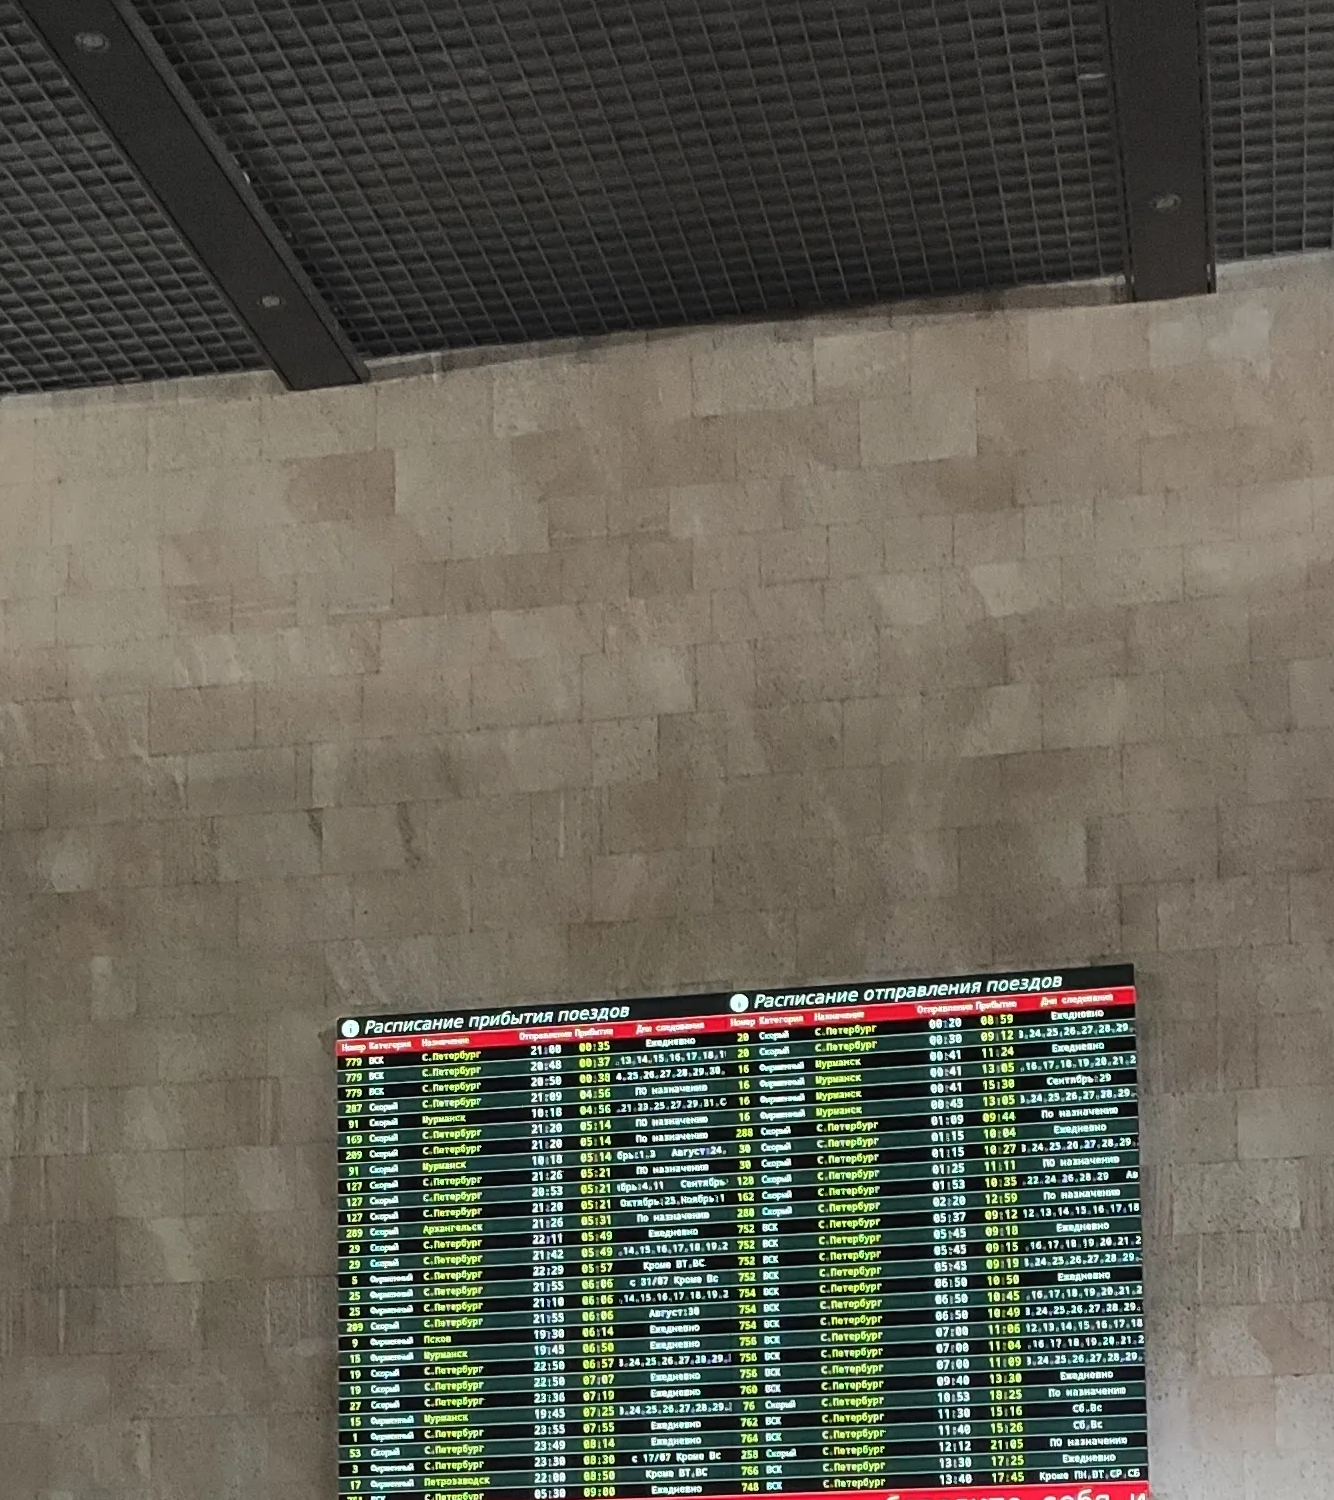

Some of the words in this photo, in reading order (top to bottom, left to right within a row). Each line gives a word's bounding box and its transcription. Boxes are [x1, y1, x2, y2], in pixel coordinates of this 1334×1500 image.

[754, 991, 858, 1008] Расписание
[863, 980, 981, 1002] отправления
[986, 975, 1063, 994] поездов
[365, 1019, 462, 1035] Расписание
[469, 1011, 553, 1030] прибытия
[558, 1006, 630, 1024] поездов
[730, 1018, 756, 1028] Номер
[759, 1015, 803, 1025] Категория
[759, 1030, 790, 1041] Скорый
[815, 1024, 877, 1037] С.Петербург
[342, 1043, 366, 1052] Номер
[369, 1040, 411, 1051] Категория
[421, 1037, 469, 1047] Назначение
[421, 1051, 481, 1063] С.Петербург
[370, 1227, 399, 1237] Скорый
[423, 1222, 483, 1235] Архангельск
[532, 1218, 563, 1229] 21:26
[423, 1334, 452, 1344] Псков
[423, 1350, 468, 1361] Мурманск
[991, 1456, 1024, 1467] 17:25
[424, 1476, 490, 1487] Петрозаводск
[992, 1472, 1024, 1483] 17:45
